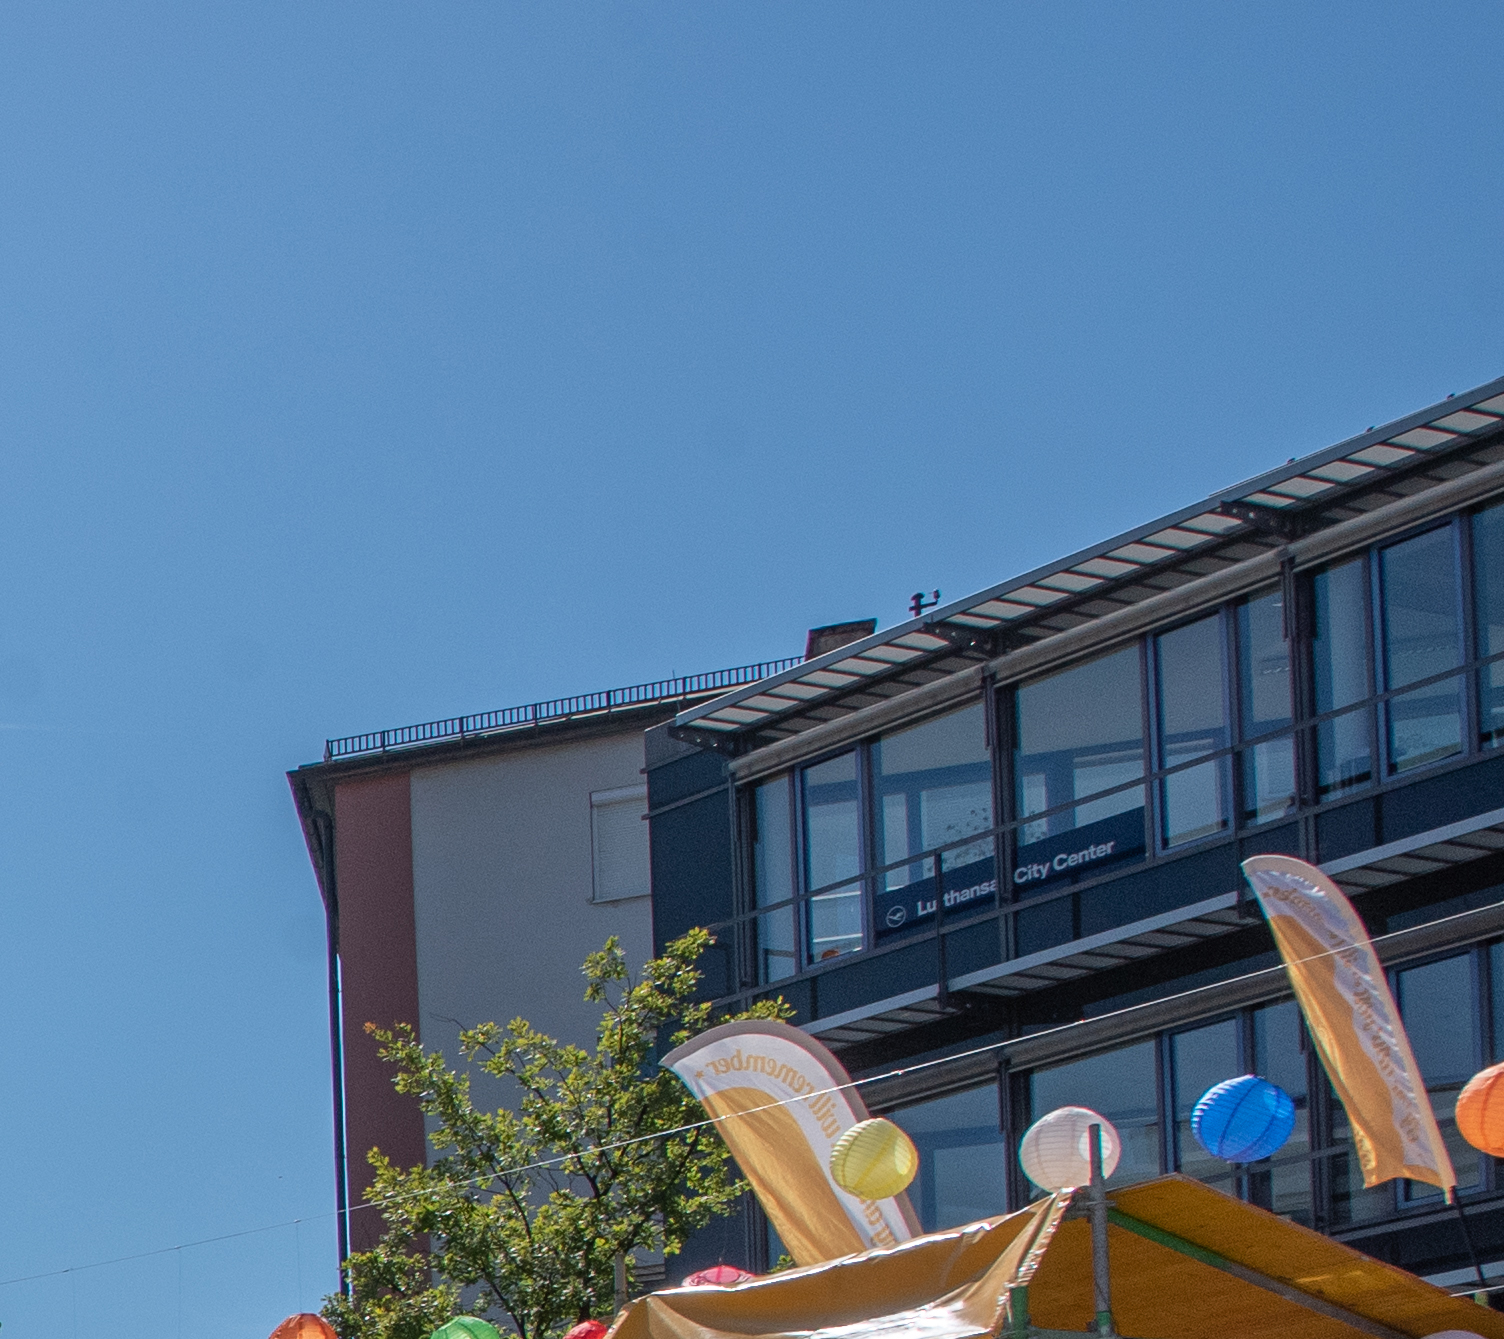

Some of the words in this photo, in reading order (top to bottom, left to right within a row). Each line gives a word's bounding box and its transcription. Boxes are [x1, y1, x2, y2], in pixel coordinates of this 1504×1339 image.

[917, 878, 997, 917] Luthansa
[1014, 860, 1050, 884] City
[1053, 840, 1116, 870] Center
